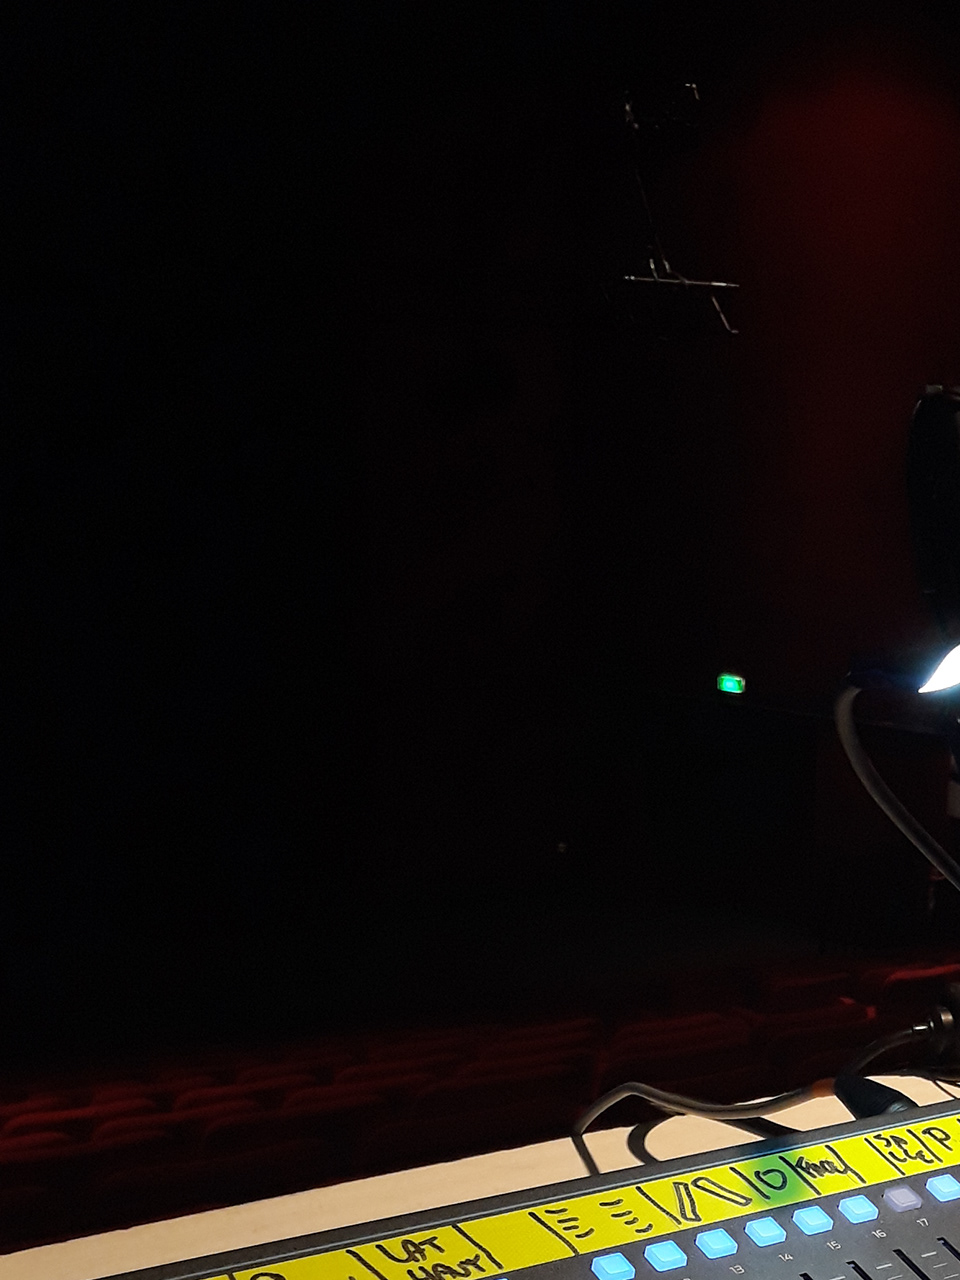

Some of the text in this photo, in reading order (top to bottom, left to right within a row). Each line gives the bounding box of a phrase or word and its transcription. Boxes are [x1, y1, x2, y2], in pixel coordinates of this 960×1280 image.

[375, 1235, 446, 1264] LAT
[728, 1264, 746, 1276] 13
[778, 1252, 795, 1262] 14
[826, 1240, 842, 1251] 15
[871, 1229, 888, 1240] 16
[917, 1217, 930, 1227] 17
